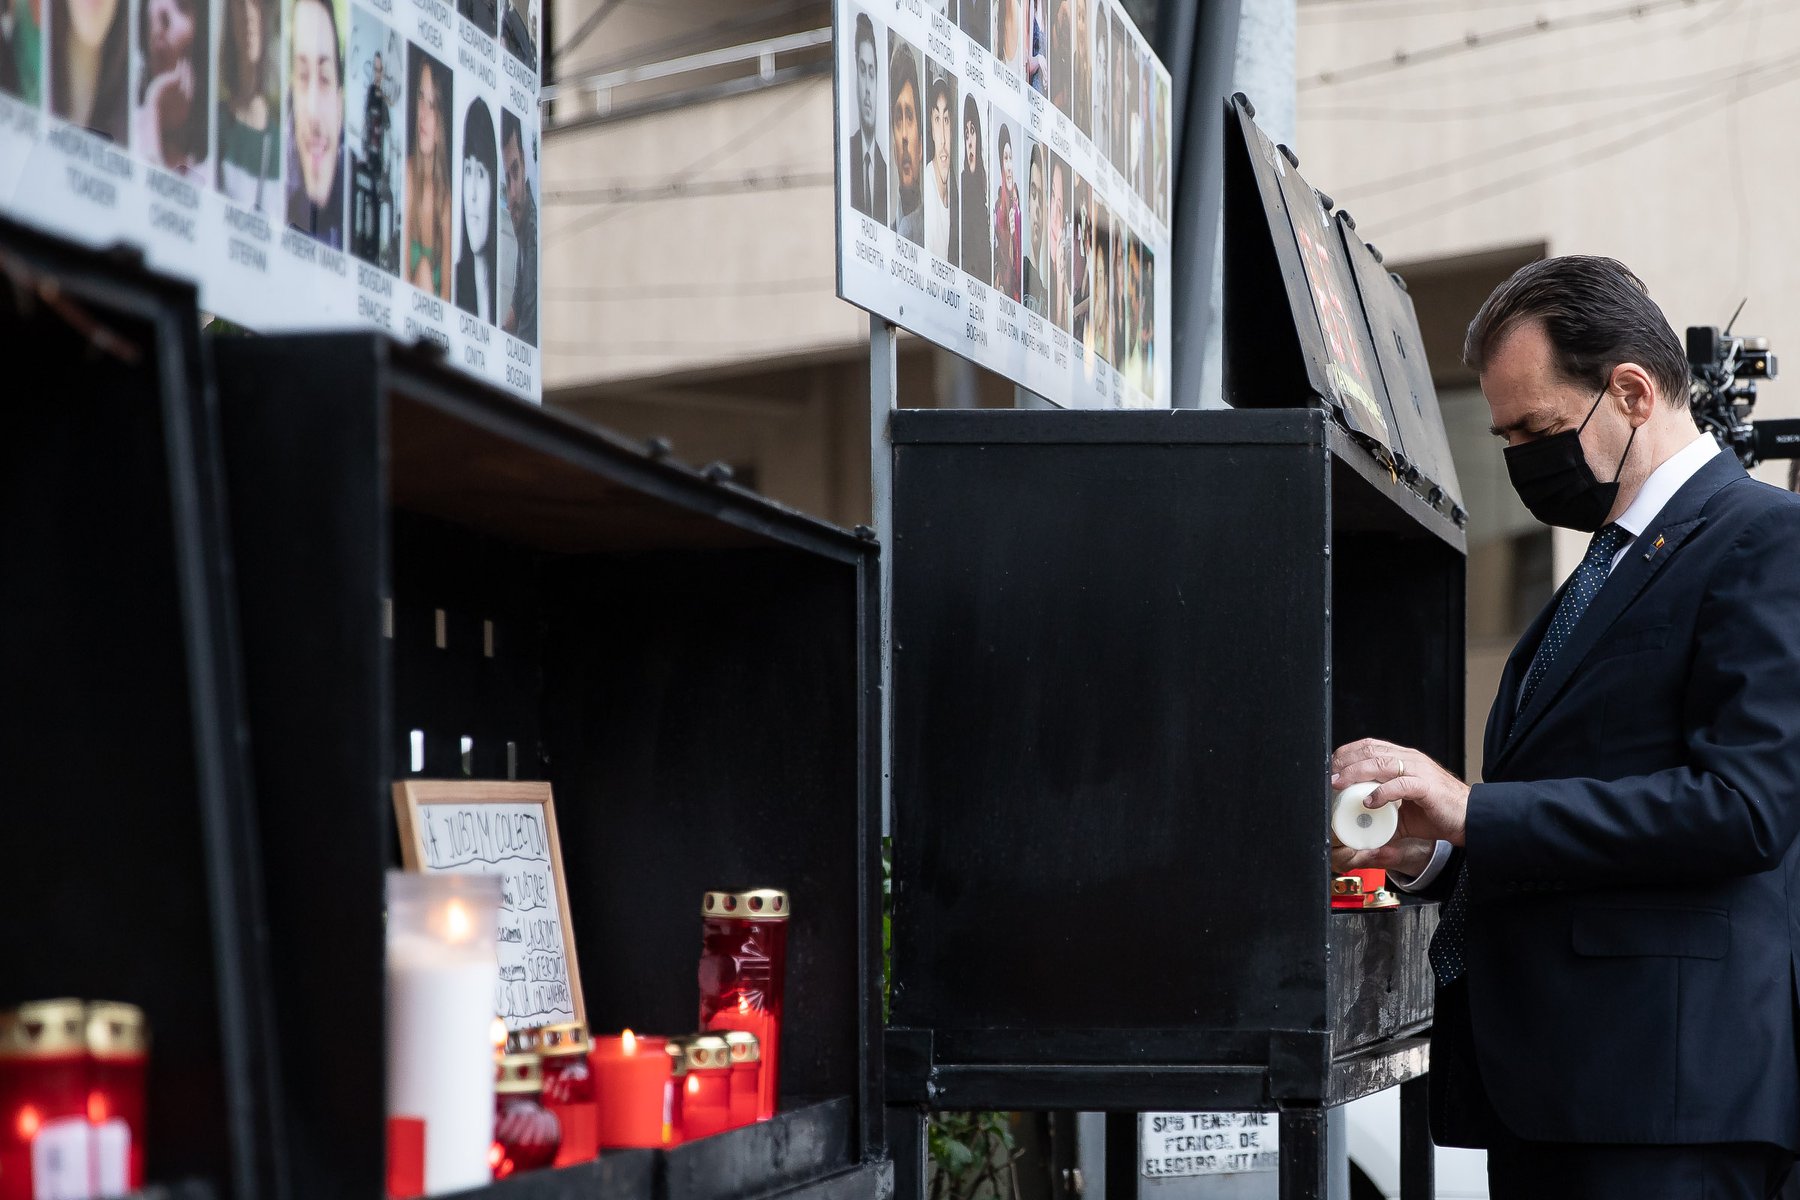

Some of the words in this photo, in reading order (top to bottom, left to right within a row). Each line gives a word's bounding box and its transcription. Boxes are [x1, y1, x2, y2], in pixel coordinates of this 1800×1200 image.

[418, 16, 443, 49] HOGEA
[931, 12, 951, 40] MARIUS
[459, 20, 496, 64] ALEXANDRU
[967, 40, 983, 64] MATEI
[503, 54, 536, 95] ALEXANDRU
[965, 61, 986, 89] GABRIEL
[510, 86, 529, 115] PASCU
[862, 218, 878, 242] RADU
[856, 240, 884, 271] SIENERTH
[896, 238, 918, 264] RAZVAN
[358, 263, 392, 299] BOGDAN
[931, 257, 956, 286] ROBERTO
[967, 278, 987, 303] ROXANA
[358, 294, 391, 328] ENACHE
[412, 291, 444, 322] CARMEN
[969, 302, 985, 323] ELENA
[999, 296, 1016, 320] SIMONA
[460, 314, 490, 345] CATALINA
[966, 322, 988, 348] BOGHIAN
[1008, 322, 1020, 342] STAN
[465, 345, 486, 371] IONITA
[506, 338, 532, 367] CLAUDIU
[506, 364, 532, 392] BOGDAN
[1240, 1132, 1259, 1149] DE
